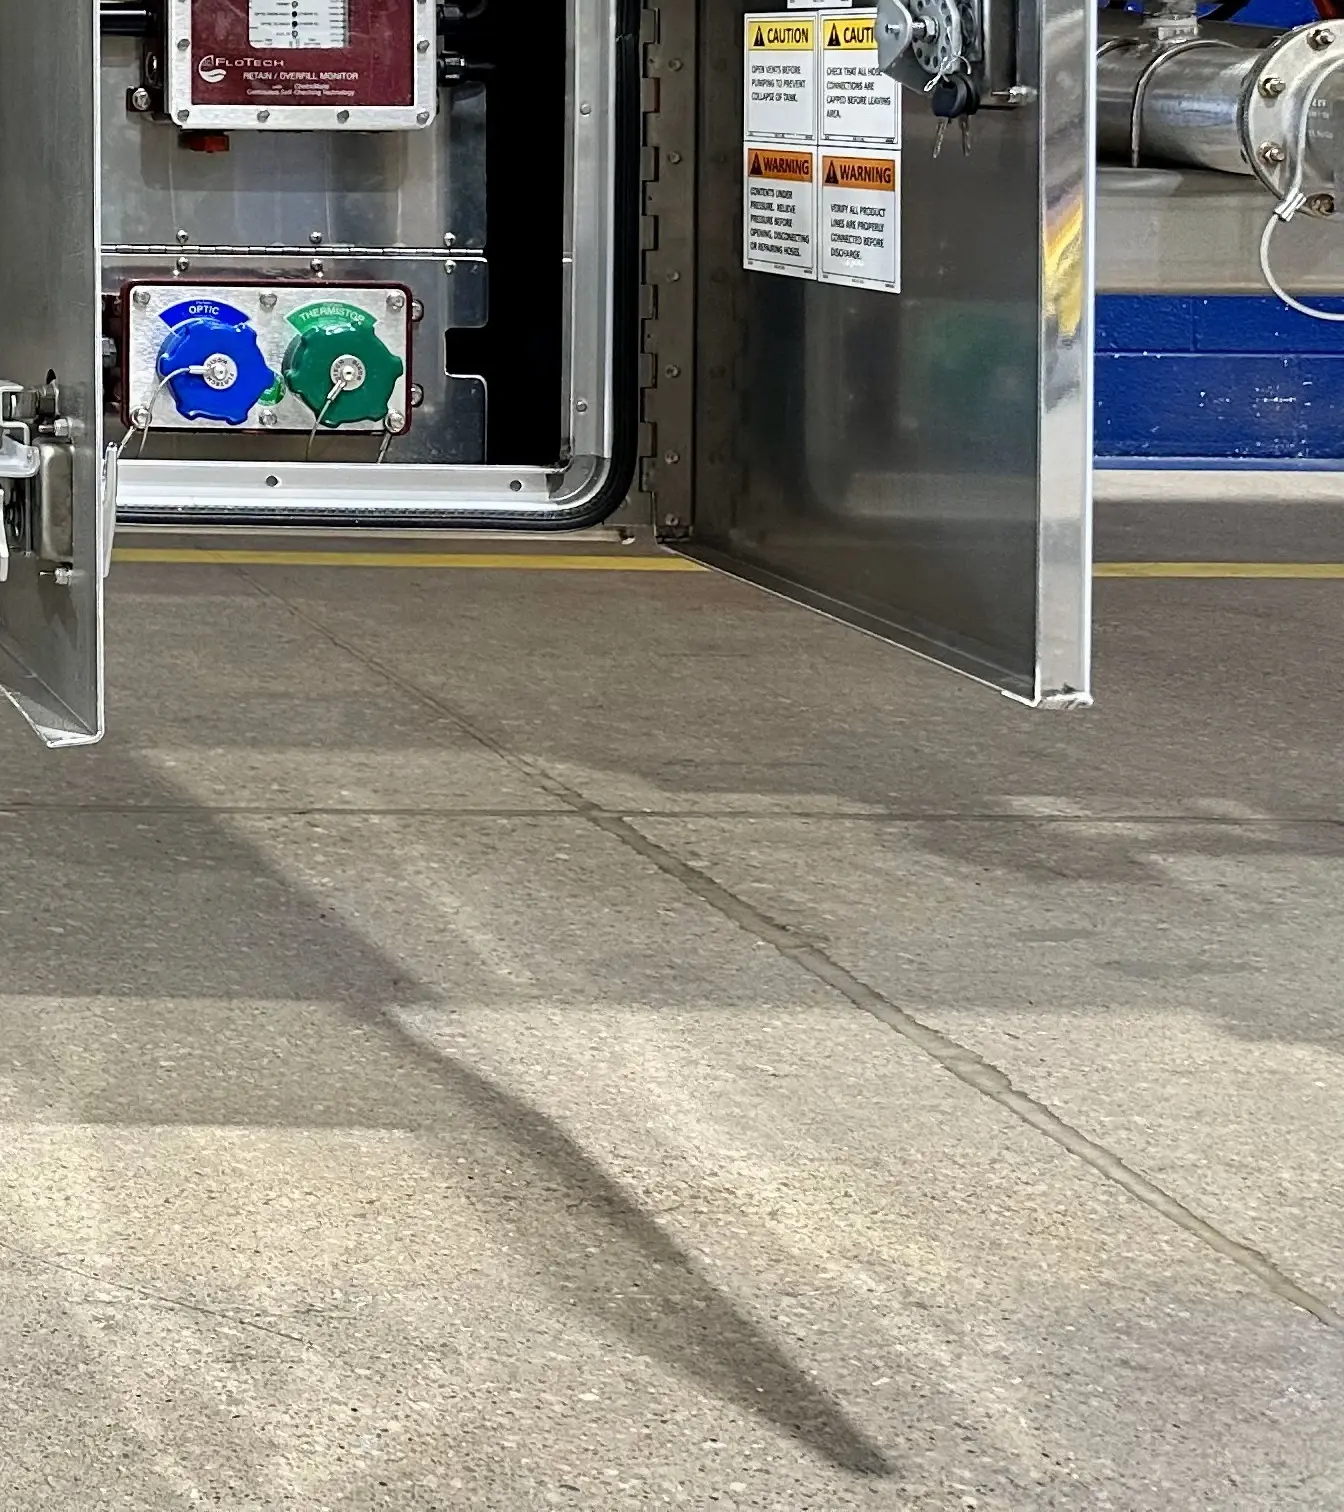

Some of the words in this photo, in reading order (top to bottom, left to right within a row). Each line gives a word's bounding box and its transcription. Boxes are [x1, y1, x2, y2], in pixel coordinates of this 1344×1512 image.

[767, 27, 809, 44] CAUTION
[843, 27, 874, 44] CAUTI
[279, 71, 316, 80] OVERFILL
[763, 156, 810, 175] WARNING
[840, 164, 892, 184] WARNING
[188, 304, 220, 316] OPTIC
[299, 306, 366, 324] THERMISTOR
